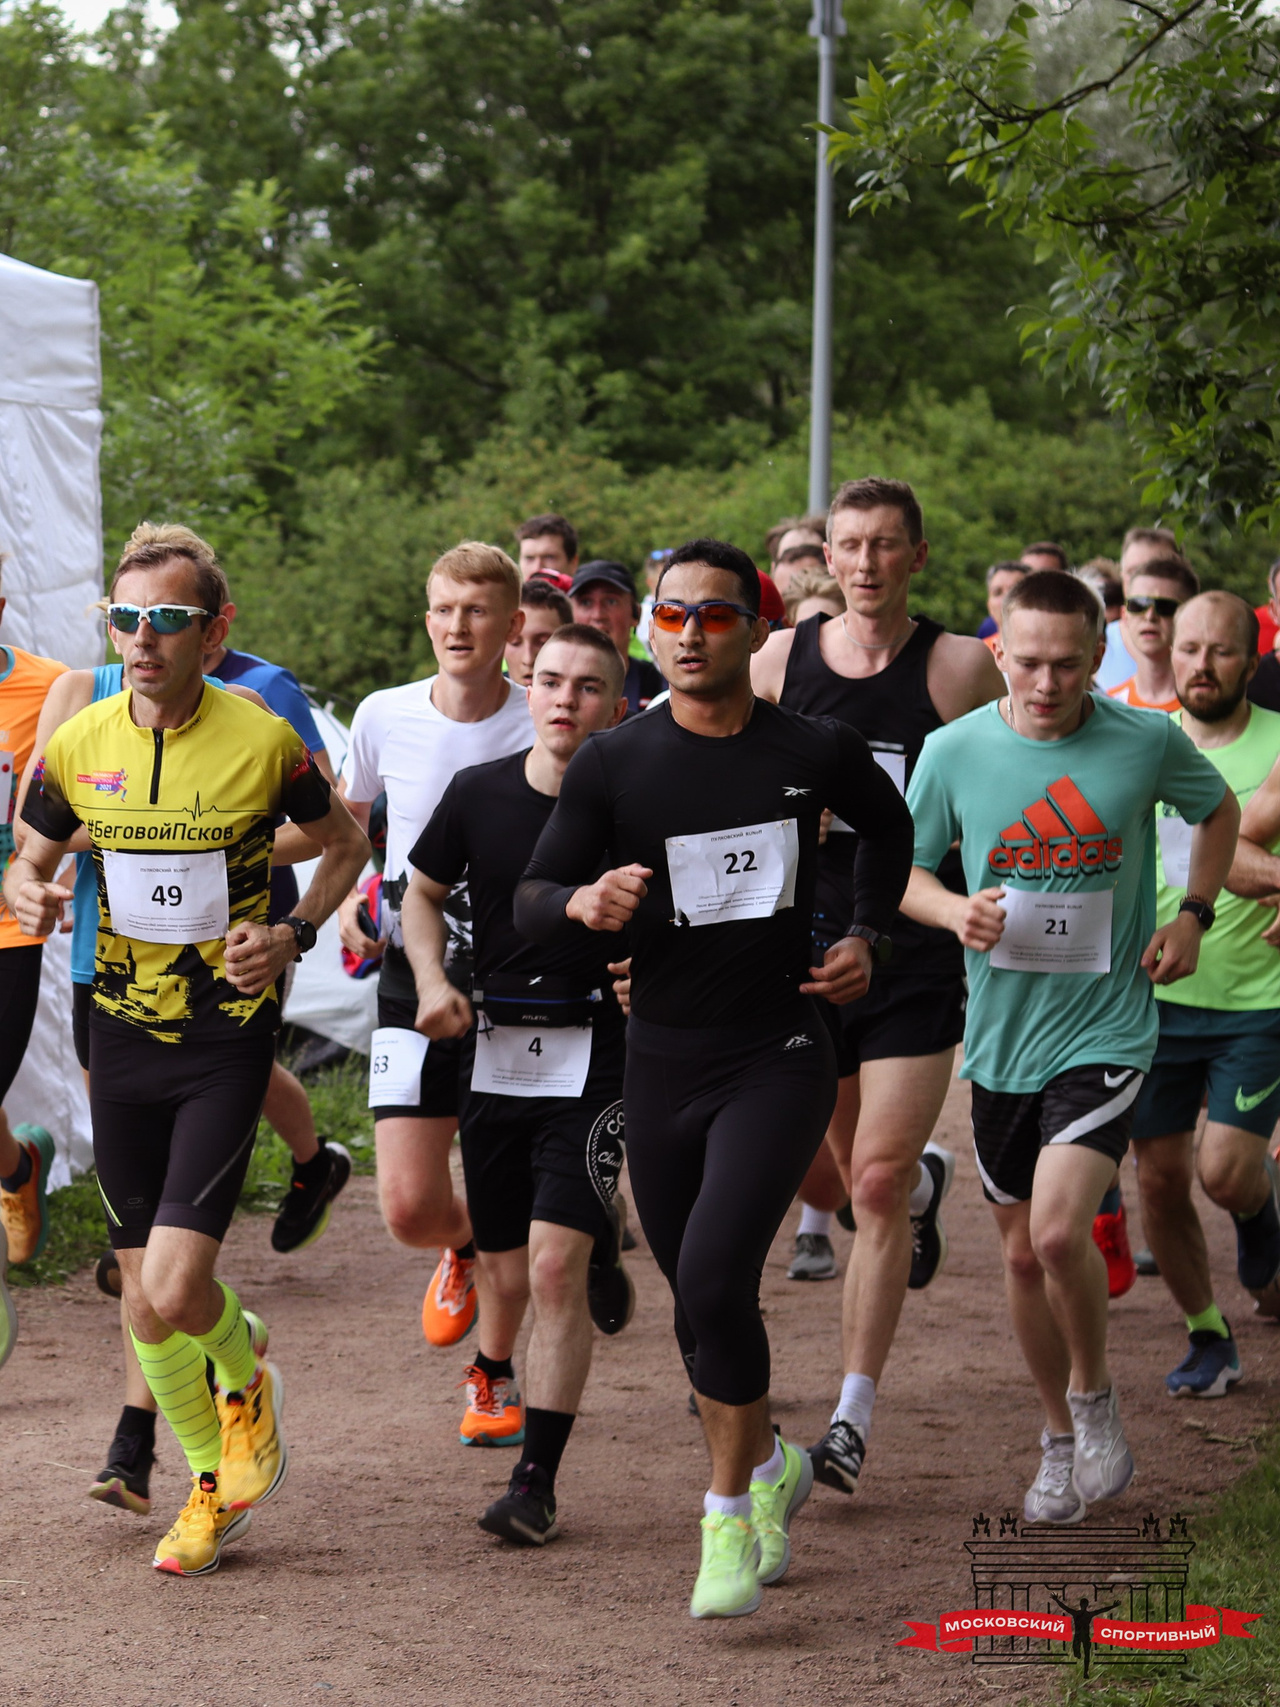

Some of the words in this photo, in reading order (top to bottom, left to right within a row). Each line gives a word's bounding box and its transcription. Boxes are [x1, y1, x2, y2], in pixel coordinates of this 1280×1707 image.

[88, 819, 234, 841] #БеговойПсков
[723, 850, 758, 875] 22
[988, 836, 1123, 879] adidas
[151, 885, 183, 907] 49
[1045, 919, 1069, 936] 21
[528, 1036, 543, 1057] 4
[373, 1055, 389, 1075] 63
[607, 1111, 625, 1135] CO
